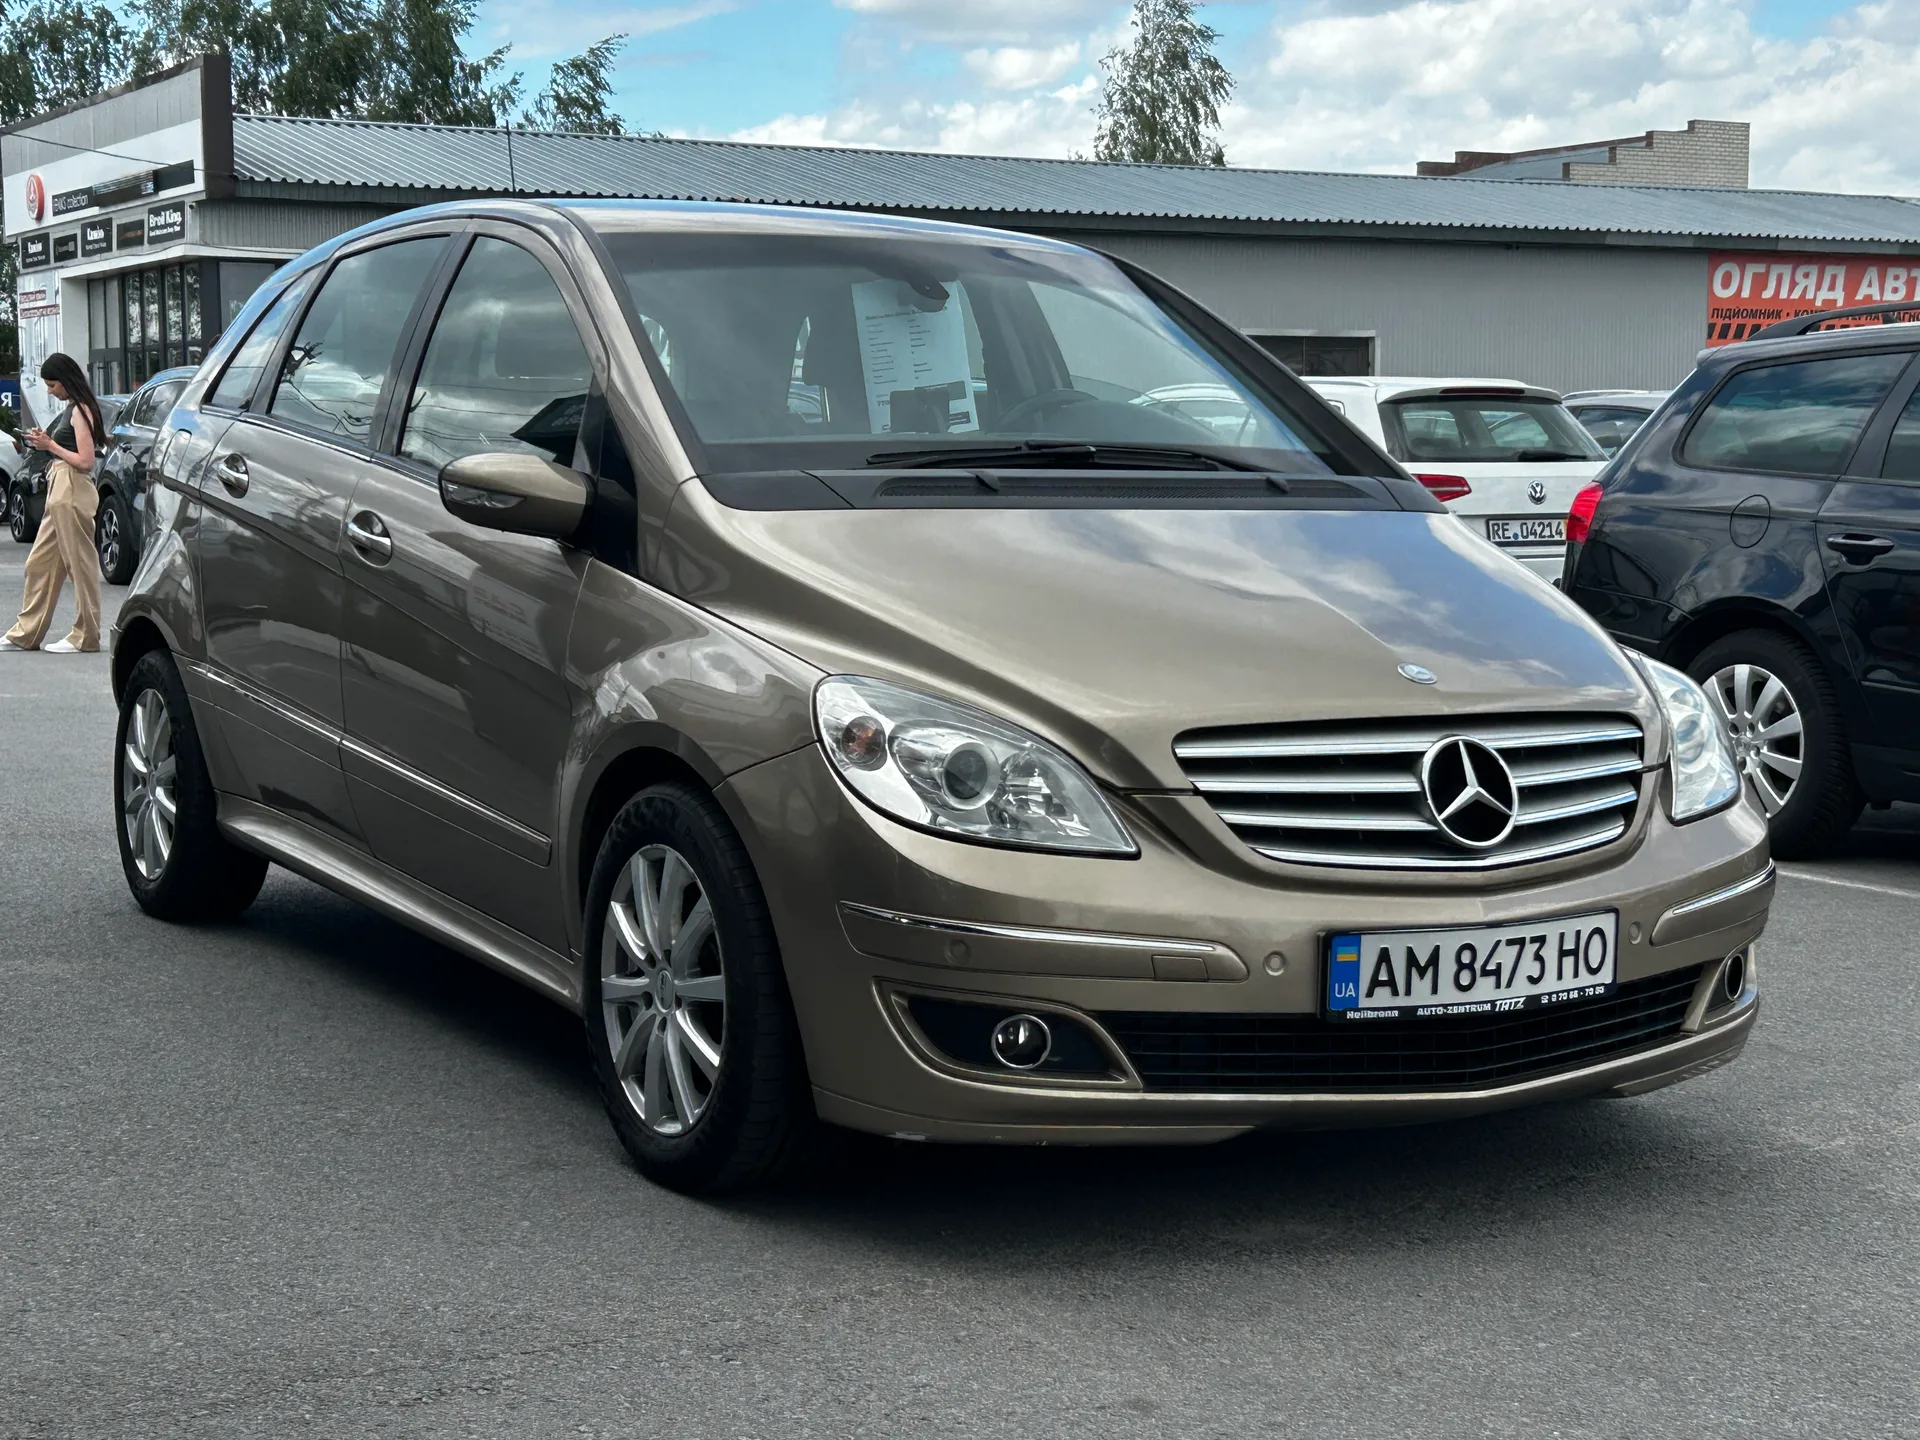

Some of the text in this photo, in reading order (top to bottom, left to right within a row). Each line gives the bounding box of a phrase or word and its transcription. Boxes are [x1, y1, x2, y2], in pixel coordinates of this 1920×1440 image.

[1712, 262, 1846, 307] ОГЛЯД
[1711, 306, 1783, 321] ПІДЙОМНИК
[1491, 521, 1563, 540] RE 04214
[1365, 926, 1608, 998] AM 8473 HO
[1334, 982, 1356, 998] UA
[1346, 1010, 1399, 1019] Heilbronn
